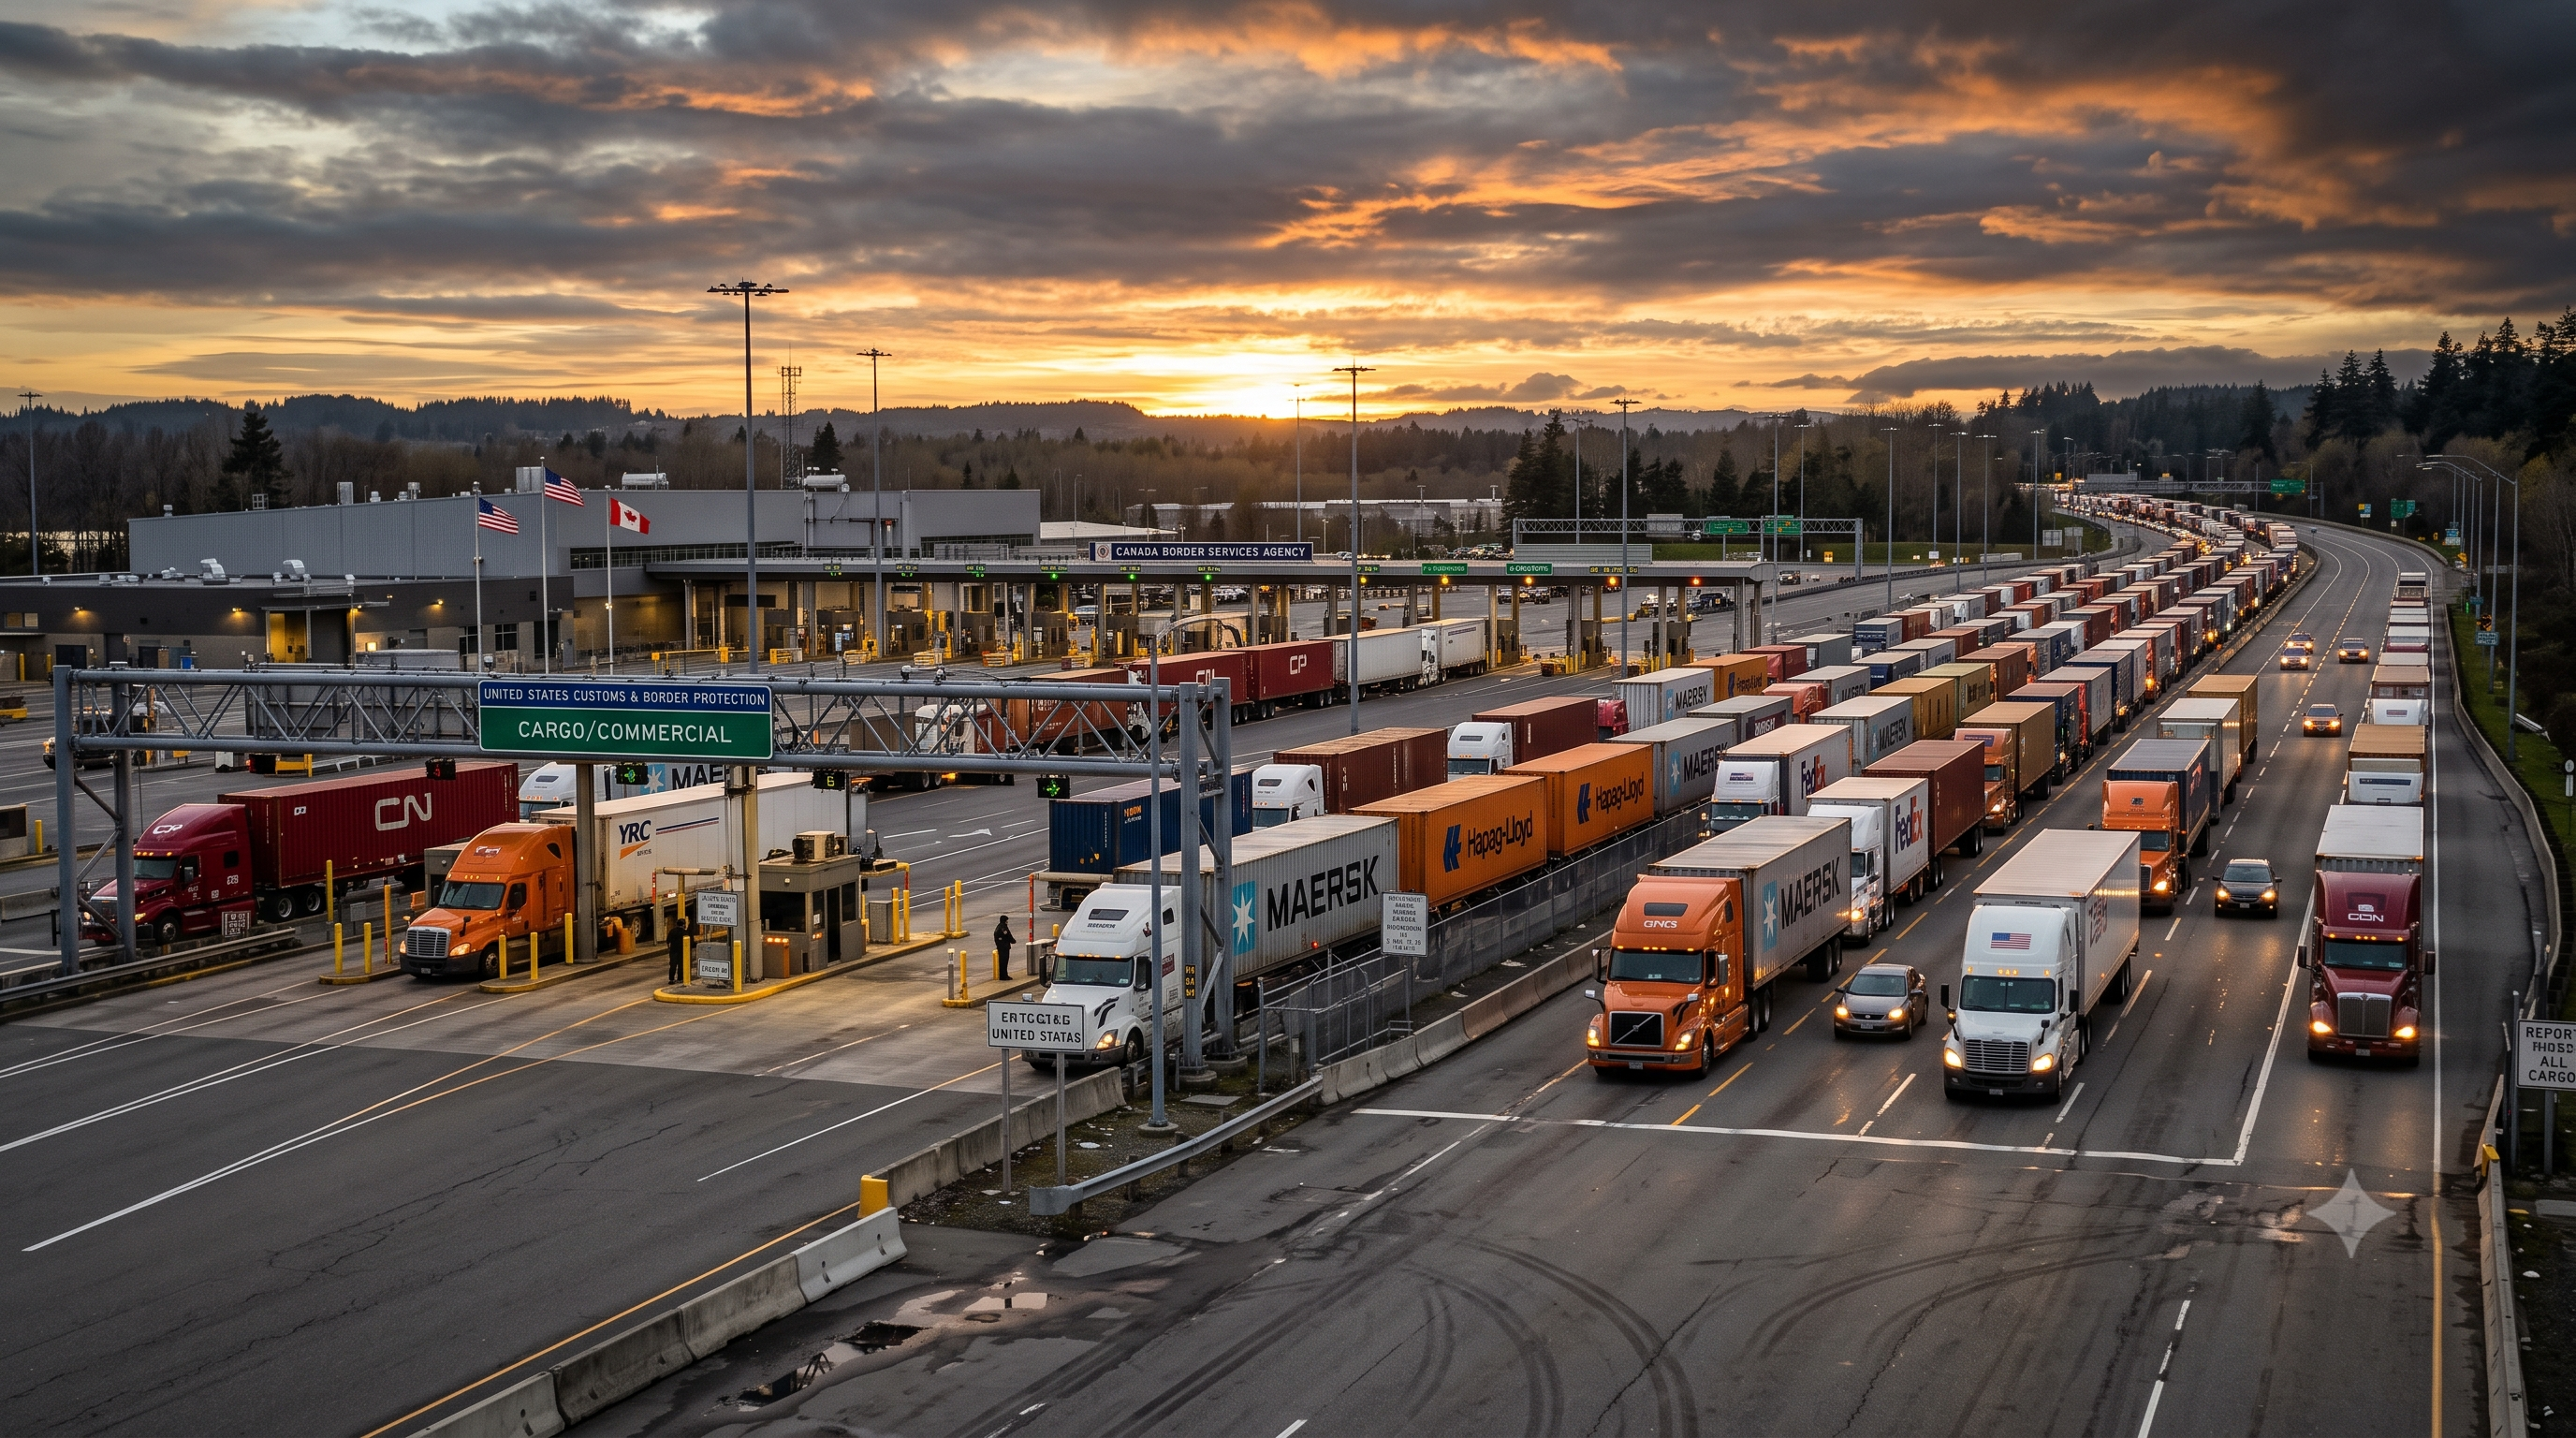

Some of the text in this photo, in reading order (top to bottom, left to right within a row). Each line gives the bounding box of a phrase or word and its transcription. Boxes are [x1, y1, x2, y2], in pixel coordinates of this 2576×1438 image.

[1116, 547, 1306, 557] CANADA BORDER SERVICES AGENCY
[1290, 654, 1307, 675] CP
[484, 688, 765, 706] UNITED STATES CUSTOMS & BORDER PROTECTION
[519, 720, 732, 743] CARGO/COMMERCIAL
[375, 793, 432, 831] CN
[619, 819, 651, 844] YRC
[1467, 810, 1533, 859] Hapag-Lloyd
[1895, 795, 1924, 854] FedEx
[1267, 855, 1379, 932] MAERSK
[1780, 856, 1840, 930] MAERSK
[992, 1028, 1081, 1044] UNITED STATAS
[2525, 1026, 2576, 1040] REPOR
[2539, 1056, 2568, 1068] ALL
[2528, 1069, 2576, 1083] CARGO
